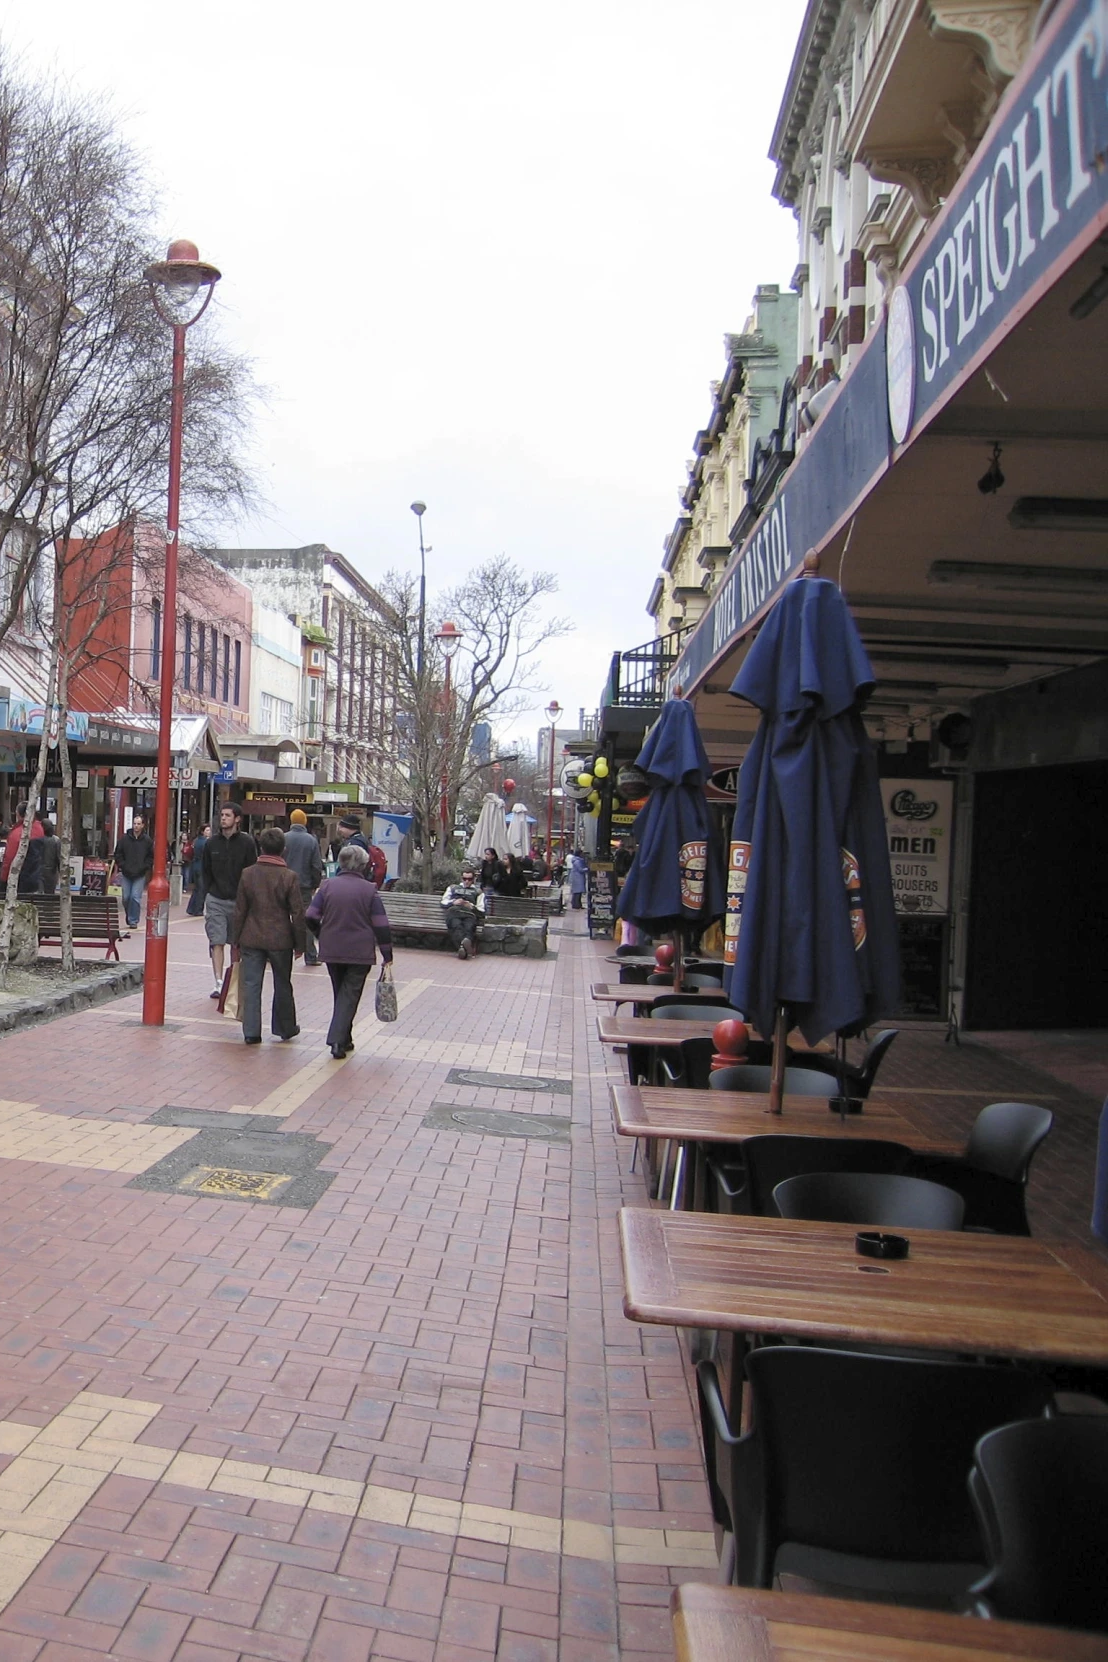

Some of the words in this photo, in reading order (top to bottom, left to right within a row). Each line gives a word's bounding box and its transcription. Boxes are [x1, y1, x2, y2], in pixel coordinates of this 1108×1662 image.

[713, 573, 737, 654] HOTEL
[740, 493, 792, 624] BRISTOL
[895, 863, 928, 877] SUITS
